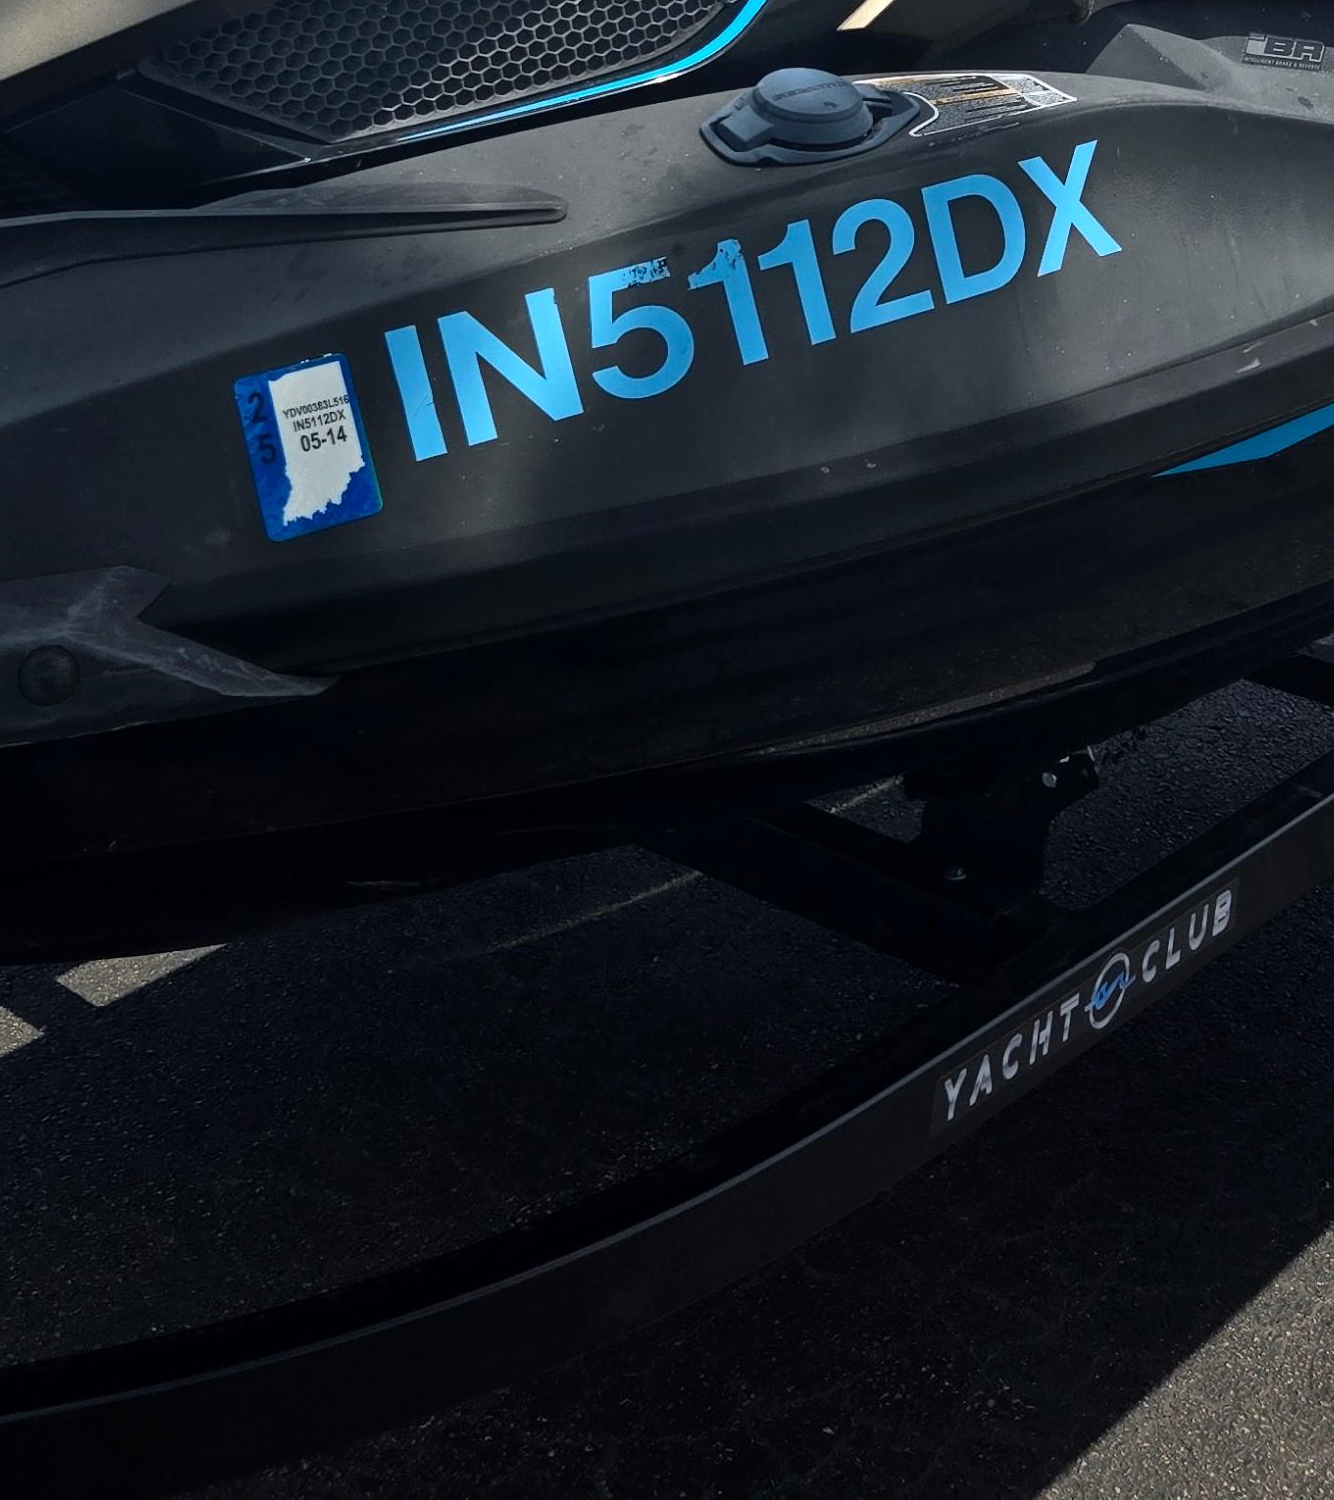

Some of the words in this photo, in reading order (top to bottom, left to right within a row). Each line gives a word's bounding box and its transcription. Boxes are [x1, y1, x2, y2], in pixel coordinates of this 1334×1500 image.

[384, 139, 1123, 462] IN5112DX
[293, 409, 347, 433] IN5112DX
[300, 425, 348, 452] 05-14
[944, 992, 1080, 1122] YACHT
[1142, 889, 1232, 983] CLUB
